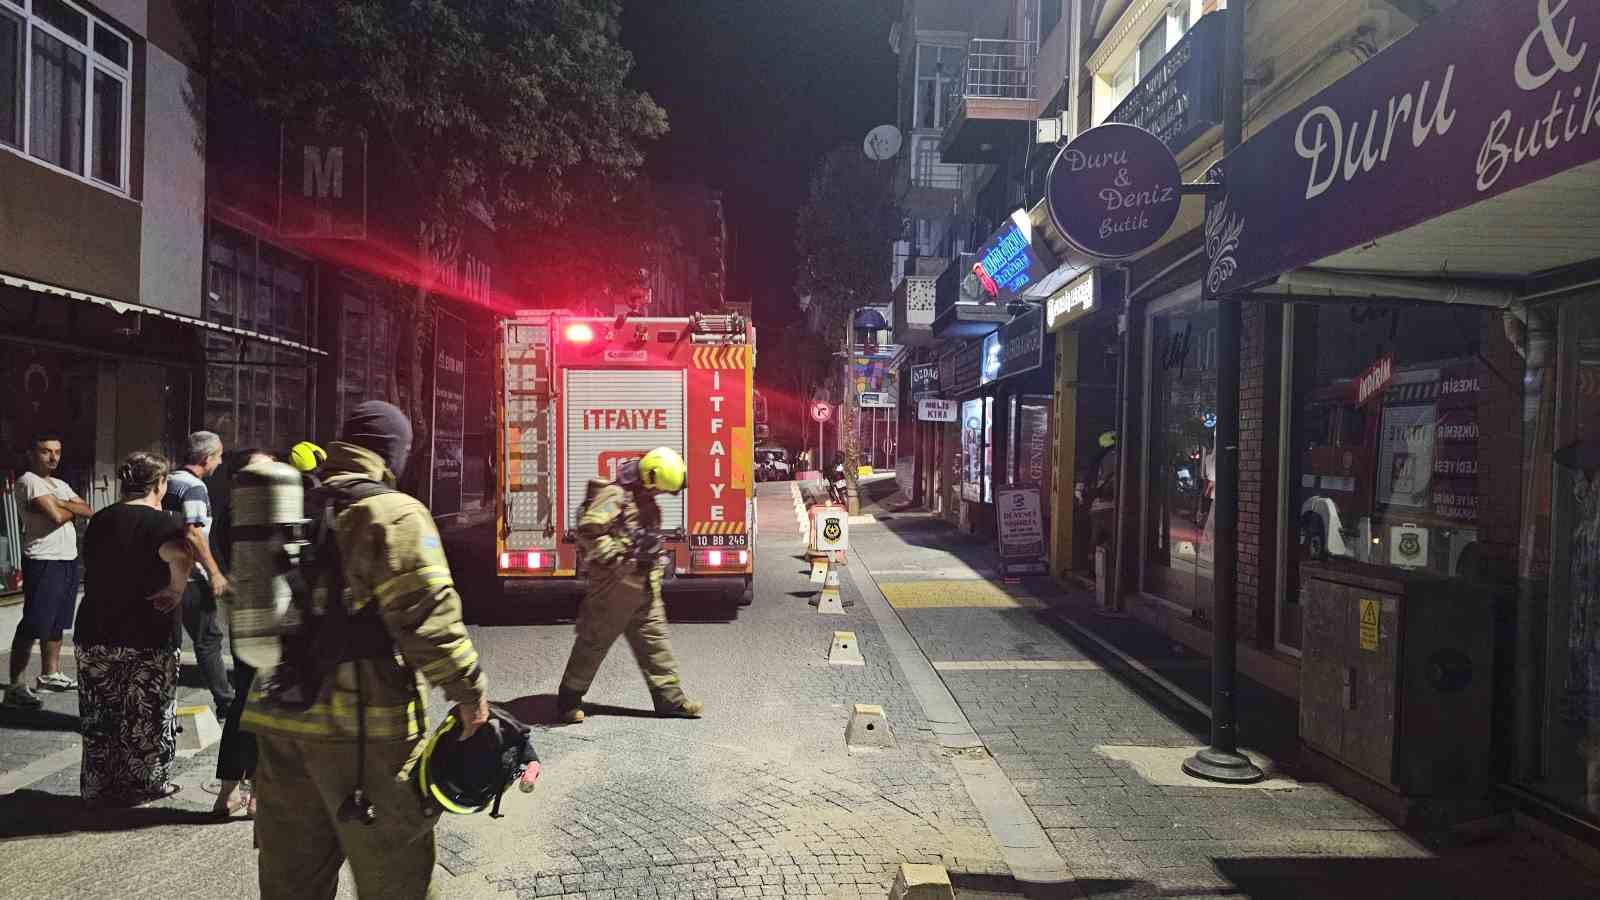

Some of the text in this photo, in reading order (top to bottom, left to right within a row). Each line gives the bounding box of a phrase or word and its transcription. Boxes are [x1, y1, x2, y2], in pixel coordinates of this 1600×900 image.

[1295, 64, 1456, 200] Duru
[1514, 0, 1588, 91] &
[303, 145, 343, 198] M
[1063, 148, 1128, 171] Duru
[1114, 168, 1132, 187] &
[1099, 184, 1173, 210] Deniz
[1098, 210, 1149, 239] Butik
[583, 408, 667, 431] İTFAİYE
[697, 534, 745, 546] 10 BB 246
